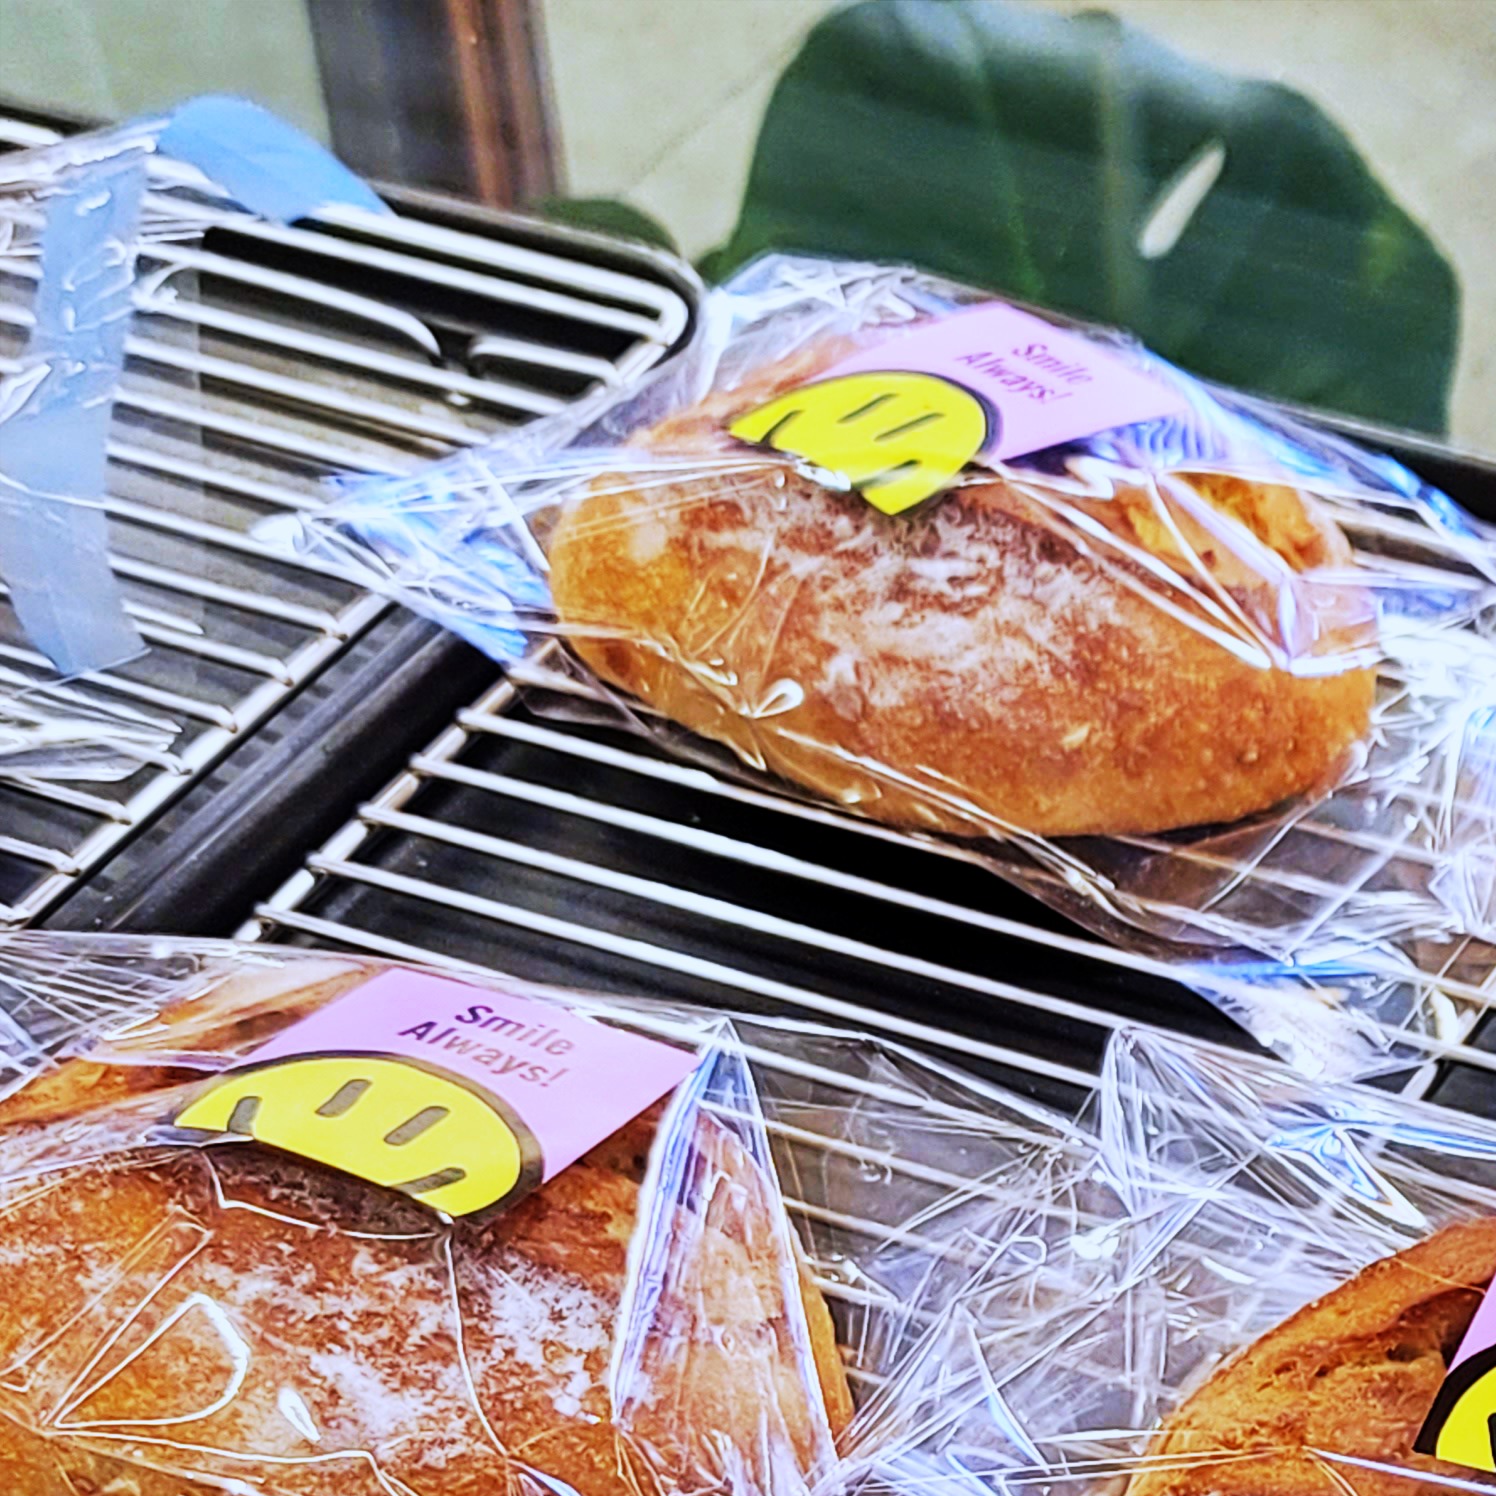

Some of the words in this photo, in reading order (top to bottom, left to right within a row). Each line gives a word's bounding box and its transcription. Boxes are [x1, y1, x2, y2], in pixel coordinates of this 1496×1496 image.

[955, 350, 1073, 405] Always!
[1011, 342, 1094, 386] Smile
[398, 1020, 568, 1088] Always!
[454, 1003, 576, 1057] Smile
